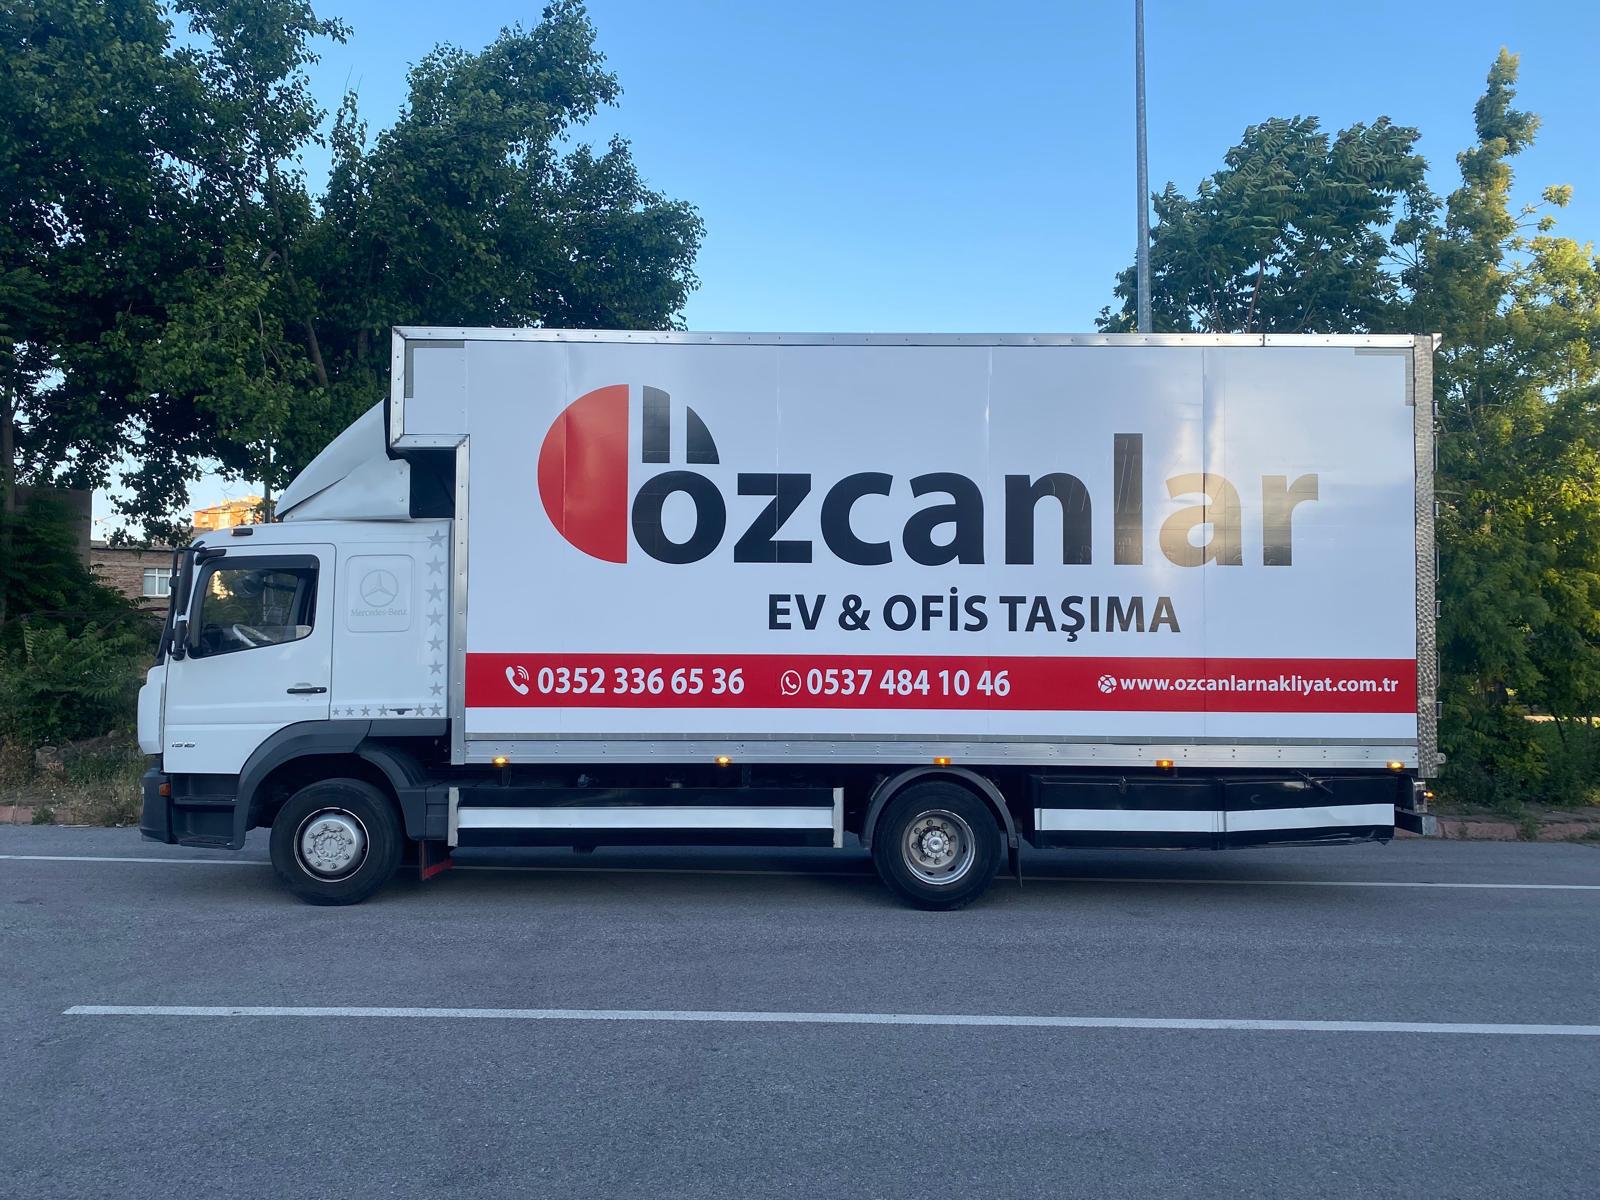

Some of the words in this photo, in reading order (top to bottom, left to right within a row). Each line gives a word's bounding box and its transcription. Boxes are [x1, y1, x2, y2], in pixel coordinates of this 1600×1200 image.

[631, 385, 1319, 567] özcanlar
[768, 594, 827, 631] EV
[838, 594, 871, 631] &
[882, 587, 988, 632] OFİS
[999, 595, 1181, 643] TAŞIMA
[537, 667, 606, 694] 0352
[613, 667, 665, 695] 336
[670, 667, 704, 695] 65
[711, 668, 745, 695] 36
[806, 668, 873, 695] 0537
[879, 669, 931, 696] 484
[938, 669, 970, 696] 10
[976, 670, 1011, 697] 46
[1119, 674, 1399, 696] www.ozcanlarnakliyat.com.tr
